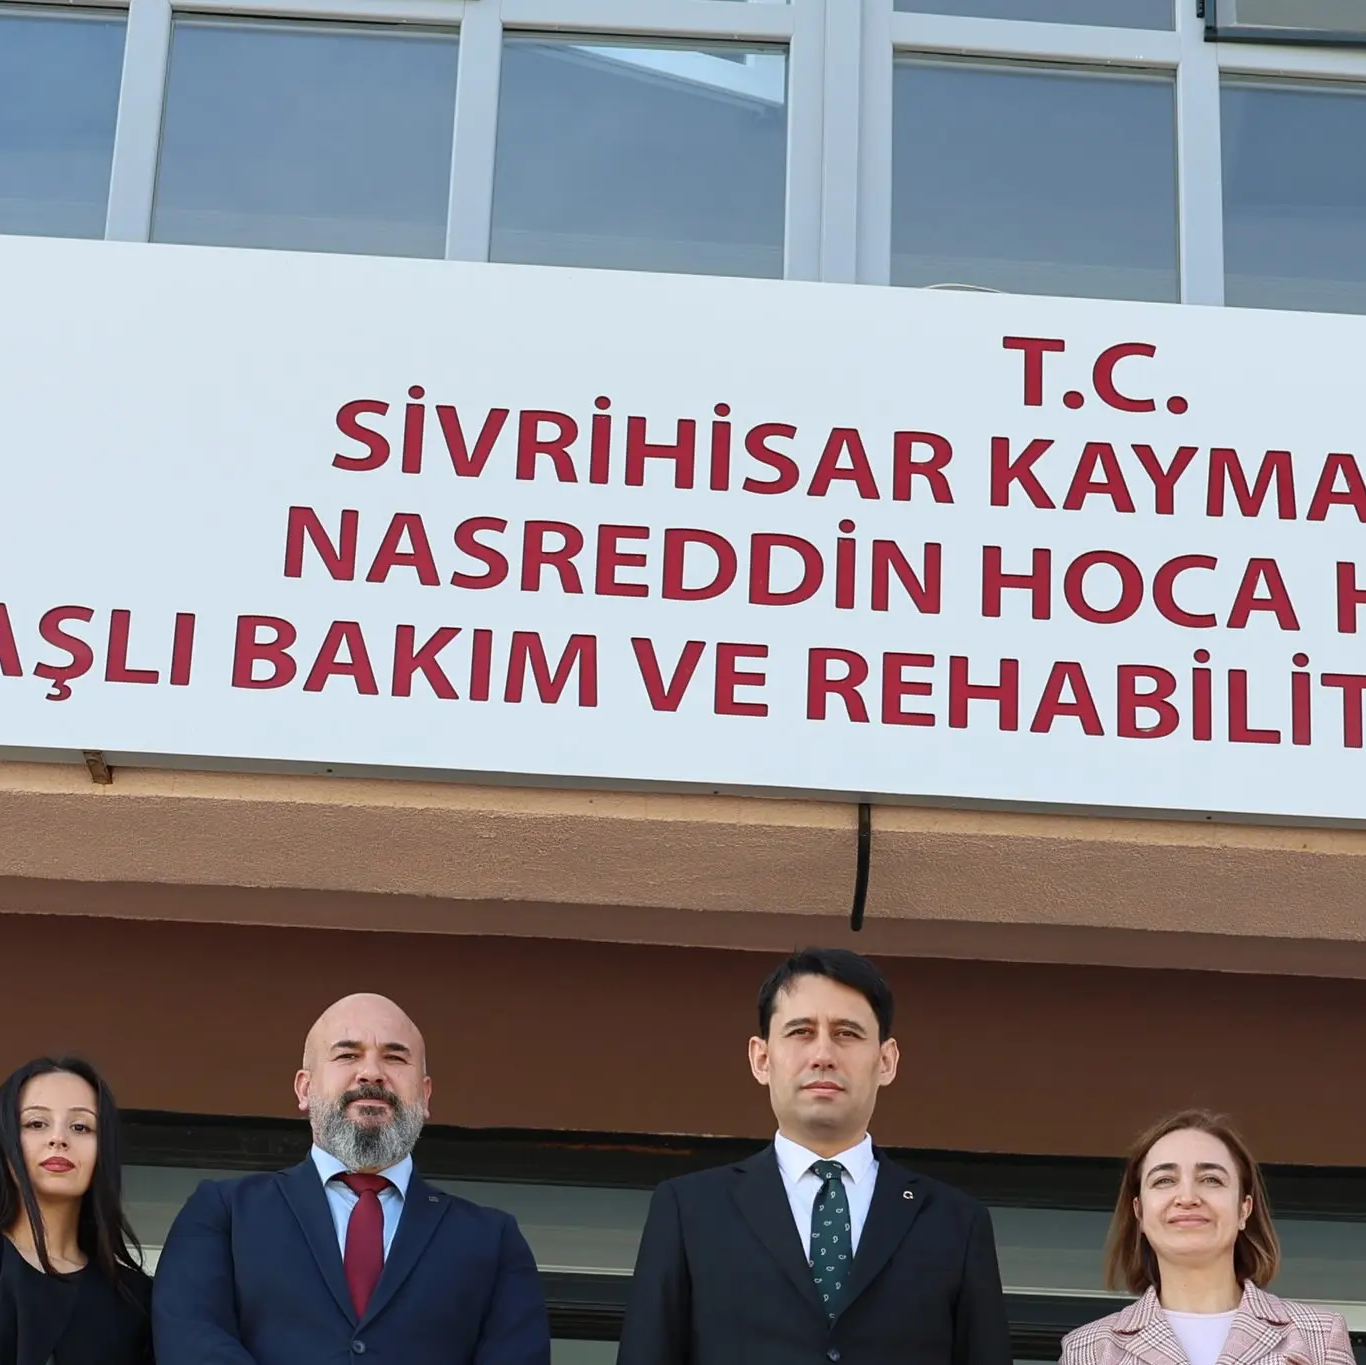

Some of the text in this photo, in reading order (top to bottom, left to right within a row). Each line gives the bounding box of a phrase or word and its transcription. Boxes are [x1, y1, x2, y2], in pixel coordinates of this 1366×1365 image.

[1002, 335, 1190, 415] T.C.
[333, 384, 954, 506] SİVRİHİSAR
[285, 505, 942, 615] NASREDDİN
[981, 545, 1300, 632] HOCA
[232, 614, 598, 708] BAKIM
[632, 637, 769, 718] VE
